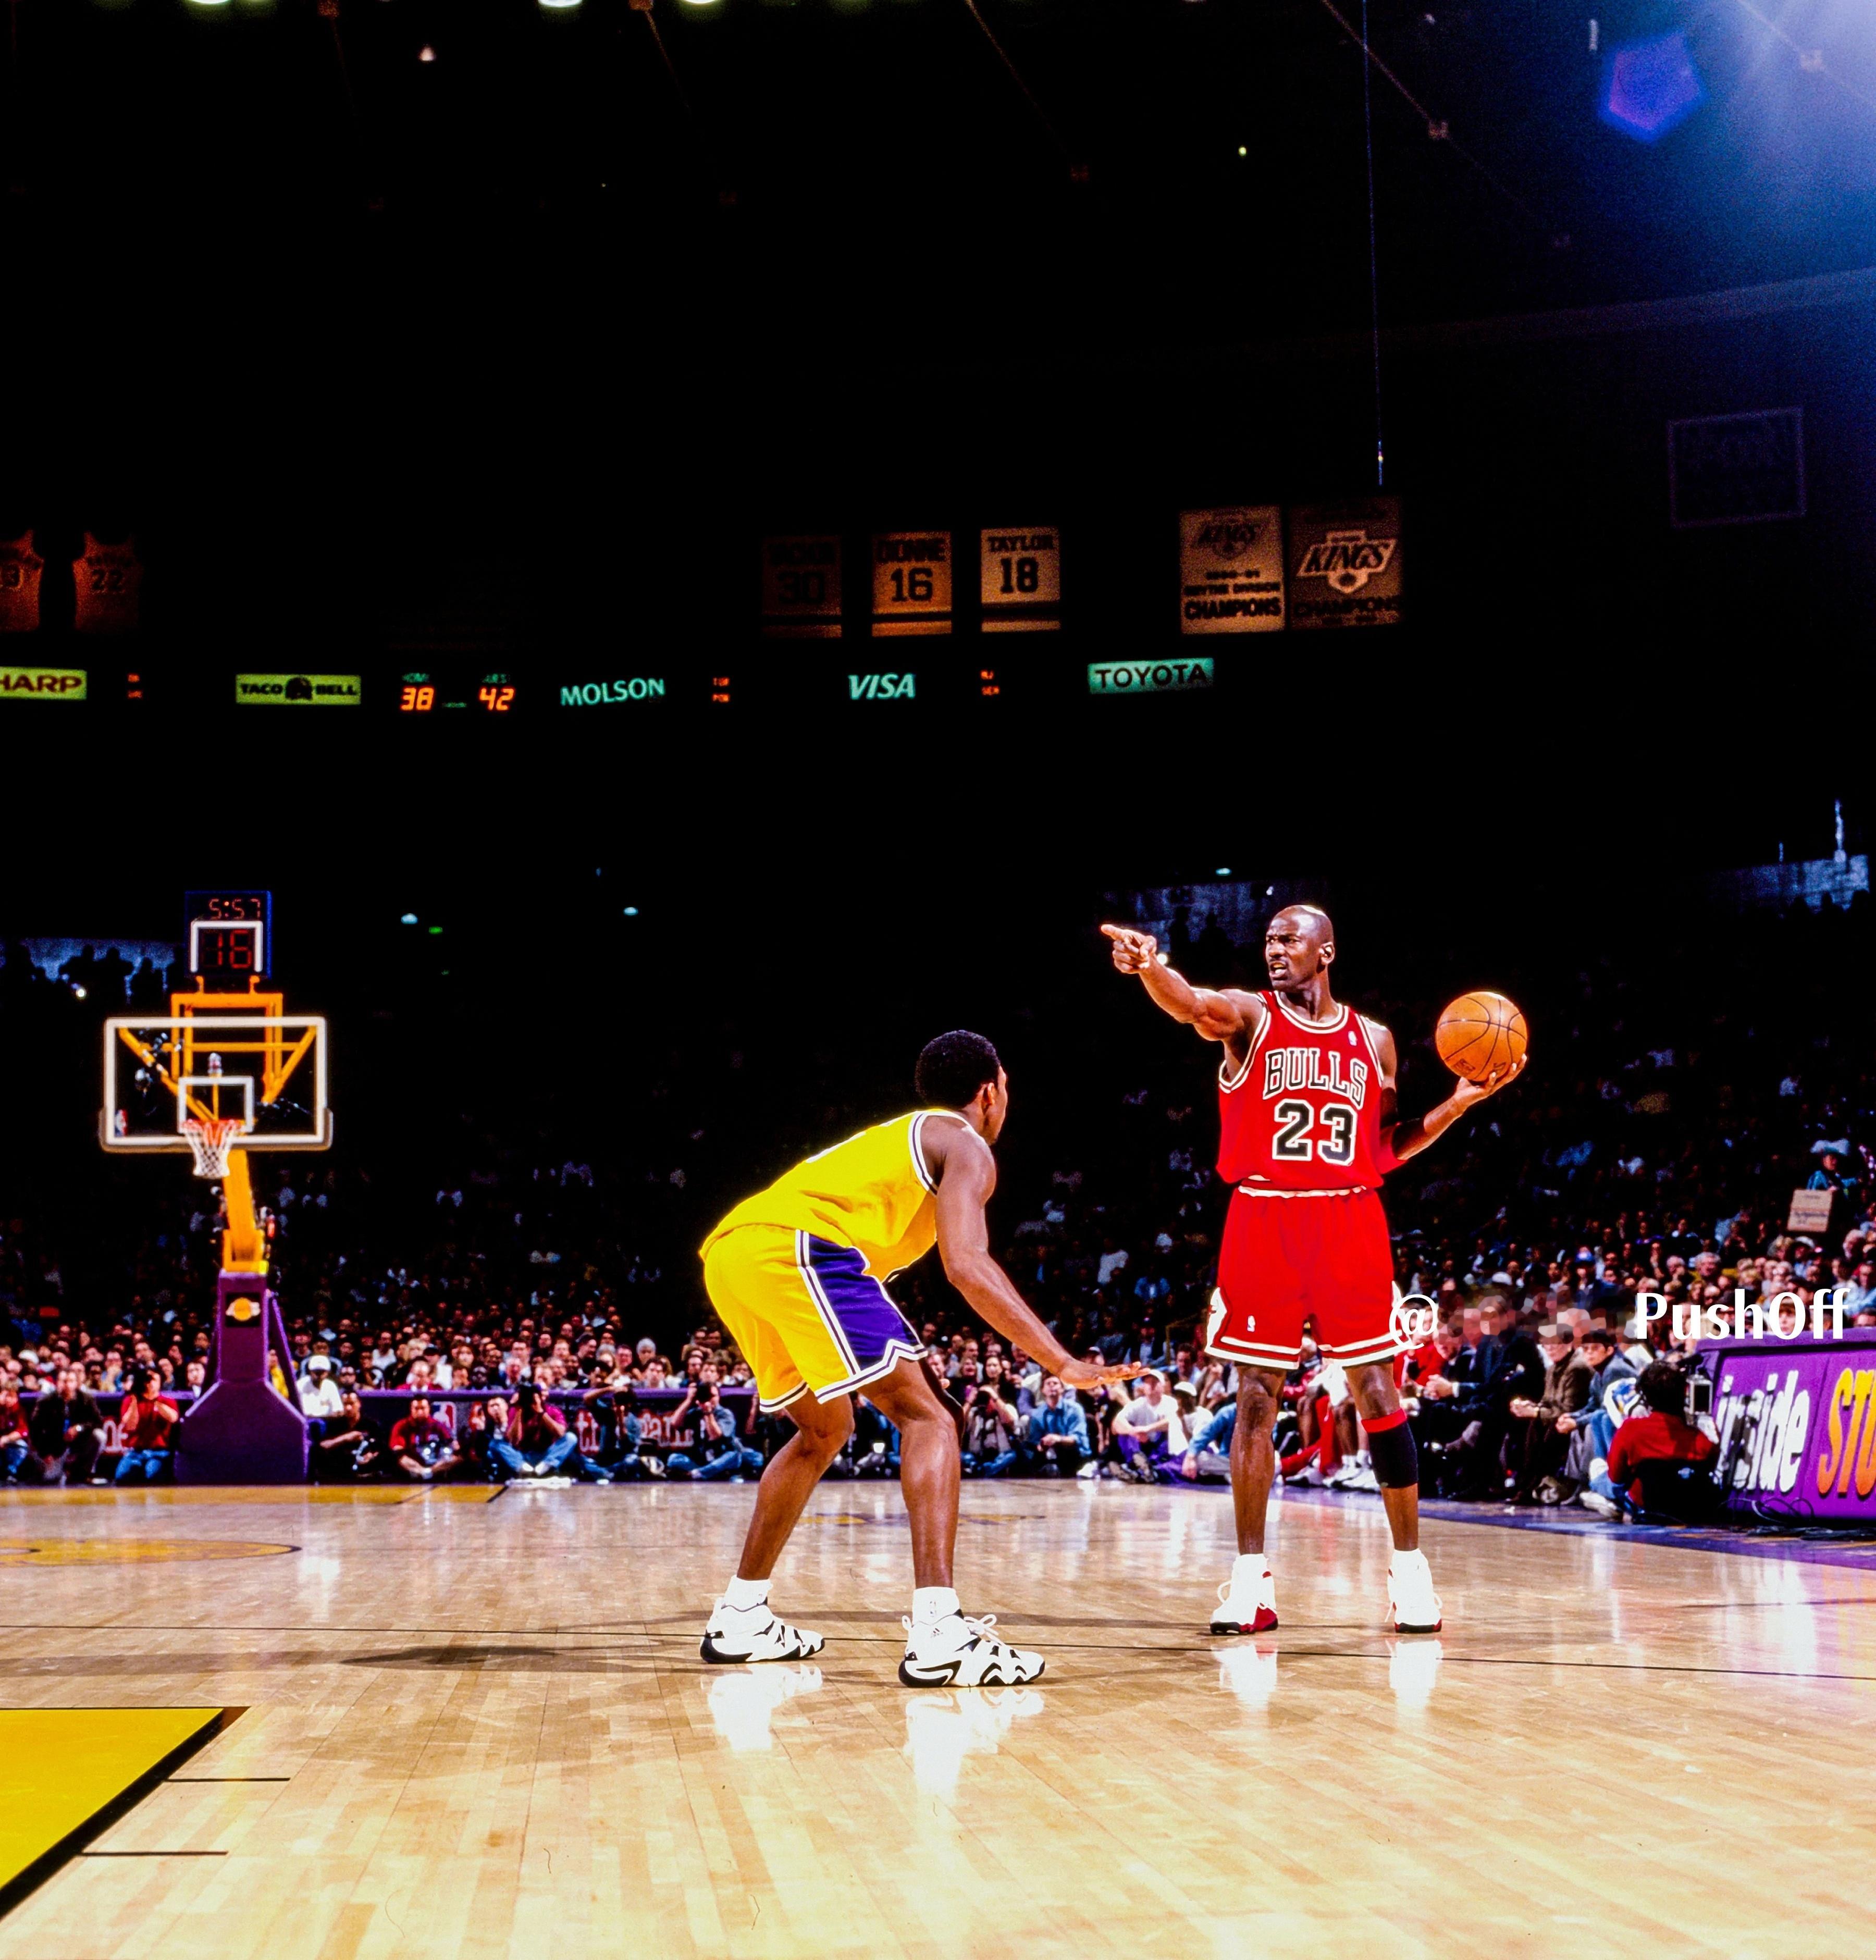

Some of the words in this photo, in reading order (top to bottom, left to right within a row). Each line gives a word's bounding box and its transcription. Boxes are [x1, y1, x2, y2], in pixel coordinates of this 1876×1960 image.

[988, 535, 1055, 552] TAYLOR
[1304, 542, 1391, 573] KINGS
[777, 571, 825, 603] 30
[891, 568, 933, 601] 16
[1001, 557, 1039, 593] 18
[1184, 597, 1281, 620] CHAMPIONS
[241, 683, 283, 694] TACO
[316, 684, 356, 695] BELL
[848, 673, 916, 699] VISA
[1095, 663, 1209, 688] TOYOTA
[401, 687, 434, 711] 38
[479, 687, 514, 711] 42
[560, 678, 665, 706] MOLSON
[208, 898, 261, 920] 5:57
[1263, 1047, 1368, 1111] BULLS
[1272, 1098, 1358, 1166] 23
